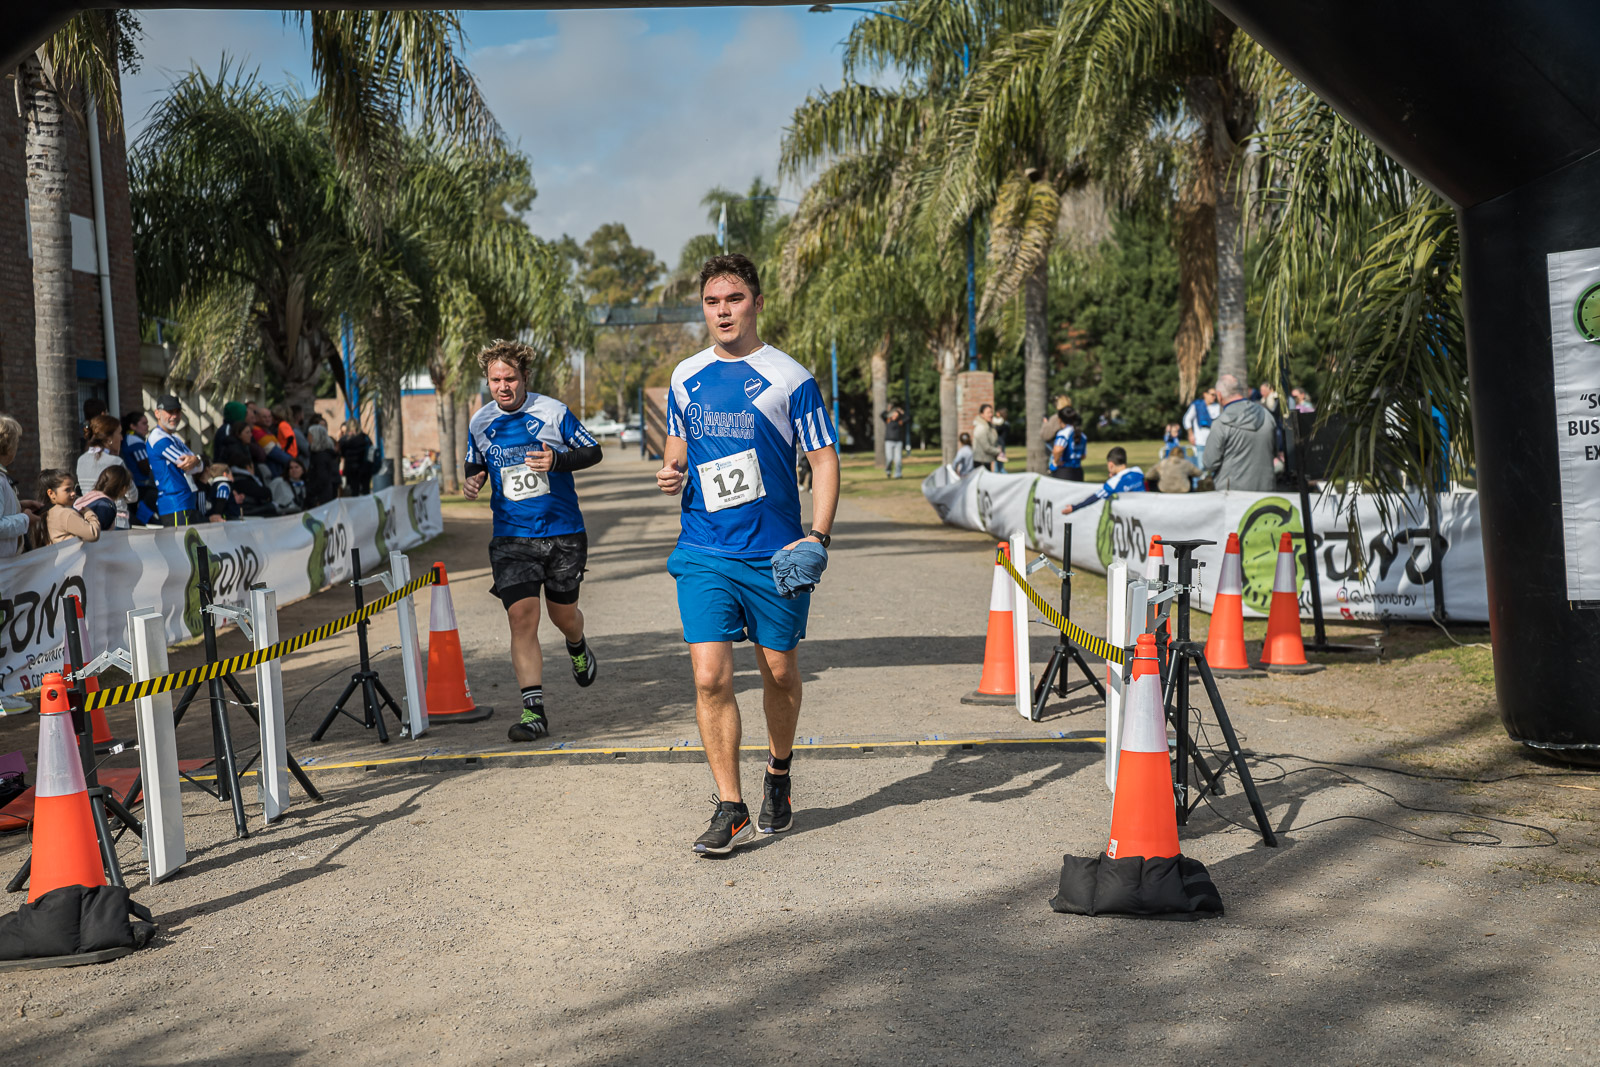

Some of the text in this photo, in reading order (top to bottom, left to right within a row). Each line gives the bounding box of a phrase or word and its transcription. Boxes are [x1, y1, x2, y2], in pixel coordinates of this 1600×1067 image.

[1580, 393, 1600, 410] “S
[687, 402, 704, 440] 3
[703, 409, 755, 429] MARATÓN
[489, 444, 505, 468] 3
[511, 472, 539, 492] 30
[712, 468, 750, 498] 12
